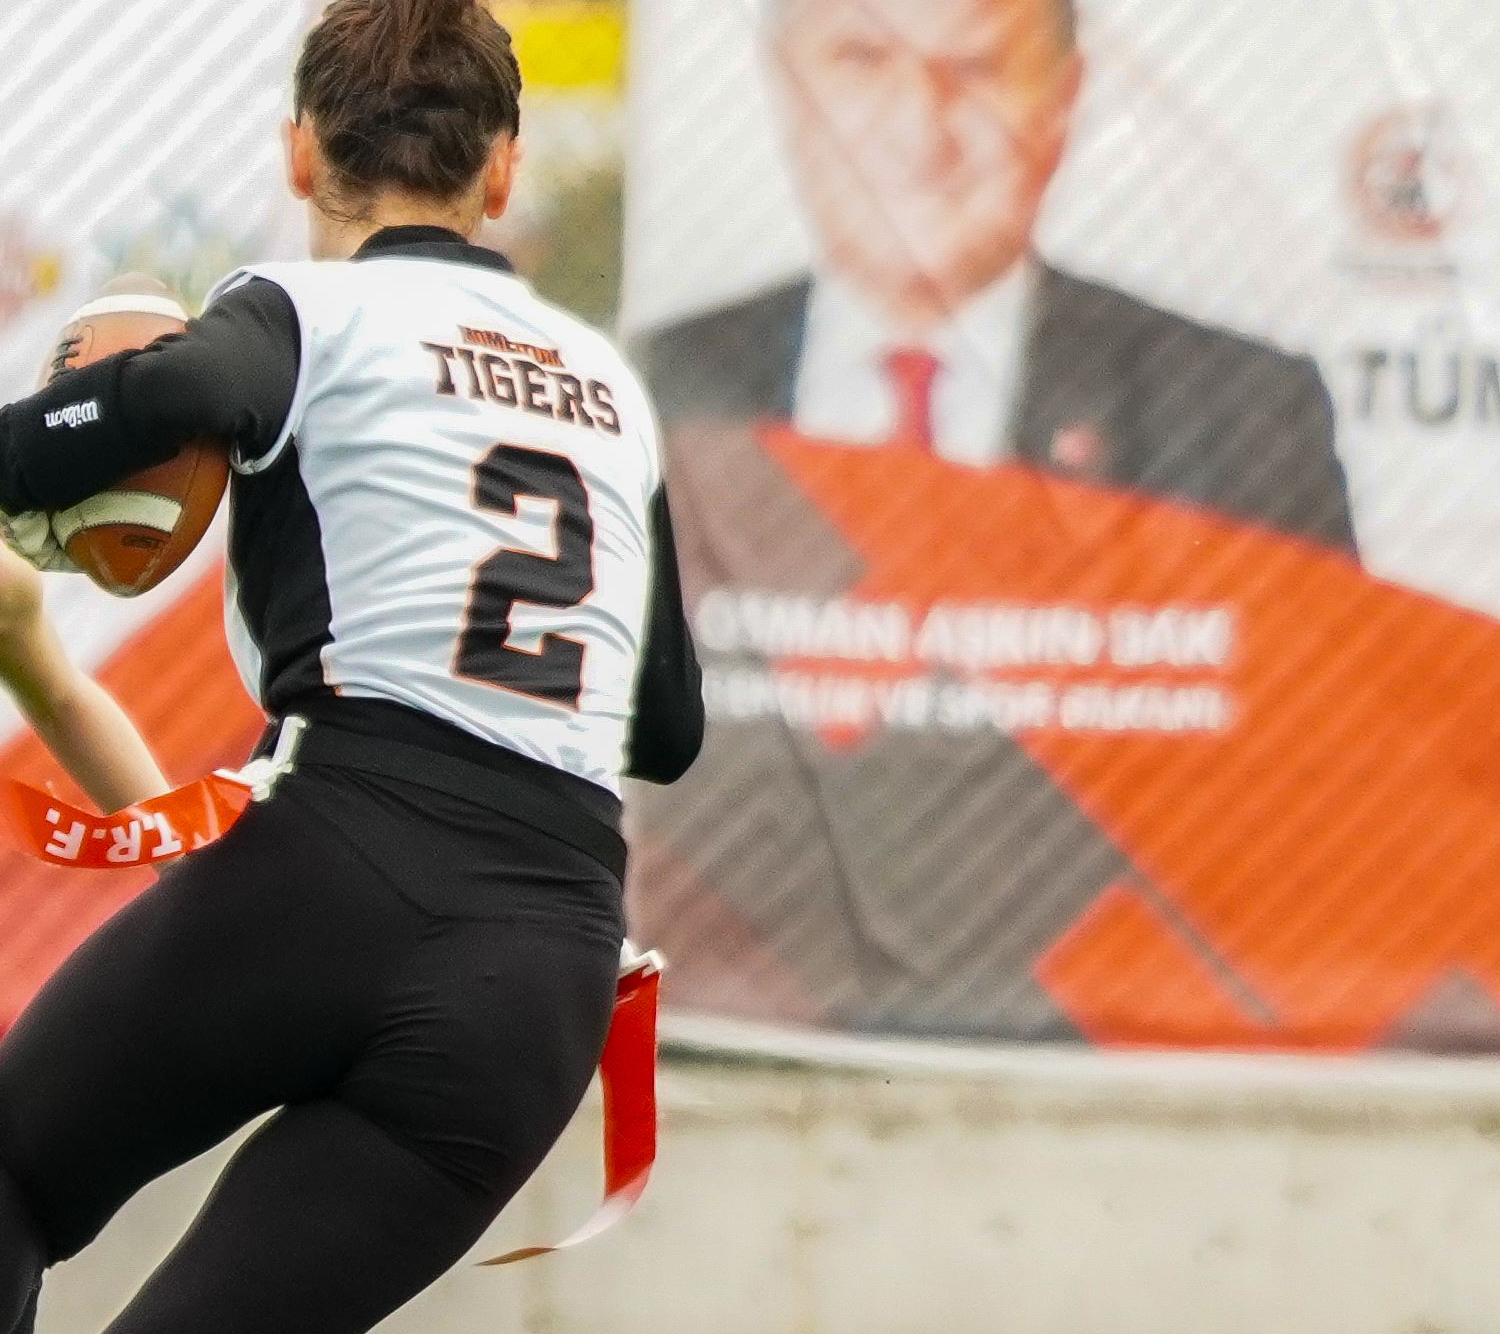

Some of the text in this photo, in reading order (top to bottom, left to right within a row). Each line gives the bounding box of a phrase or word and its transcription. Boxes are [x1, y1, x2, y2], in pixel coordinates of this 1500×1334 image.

[44, 401, 99, 428] Wilson
[419, 341, 622, 436] TIGERS
[451, 443, 597, 713] 2
[45, 807, 183, 863] T.R.F.
